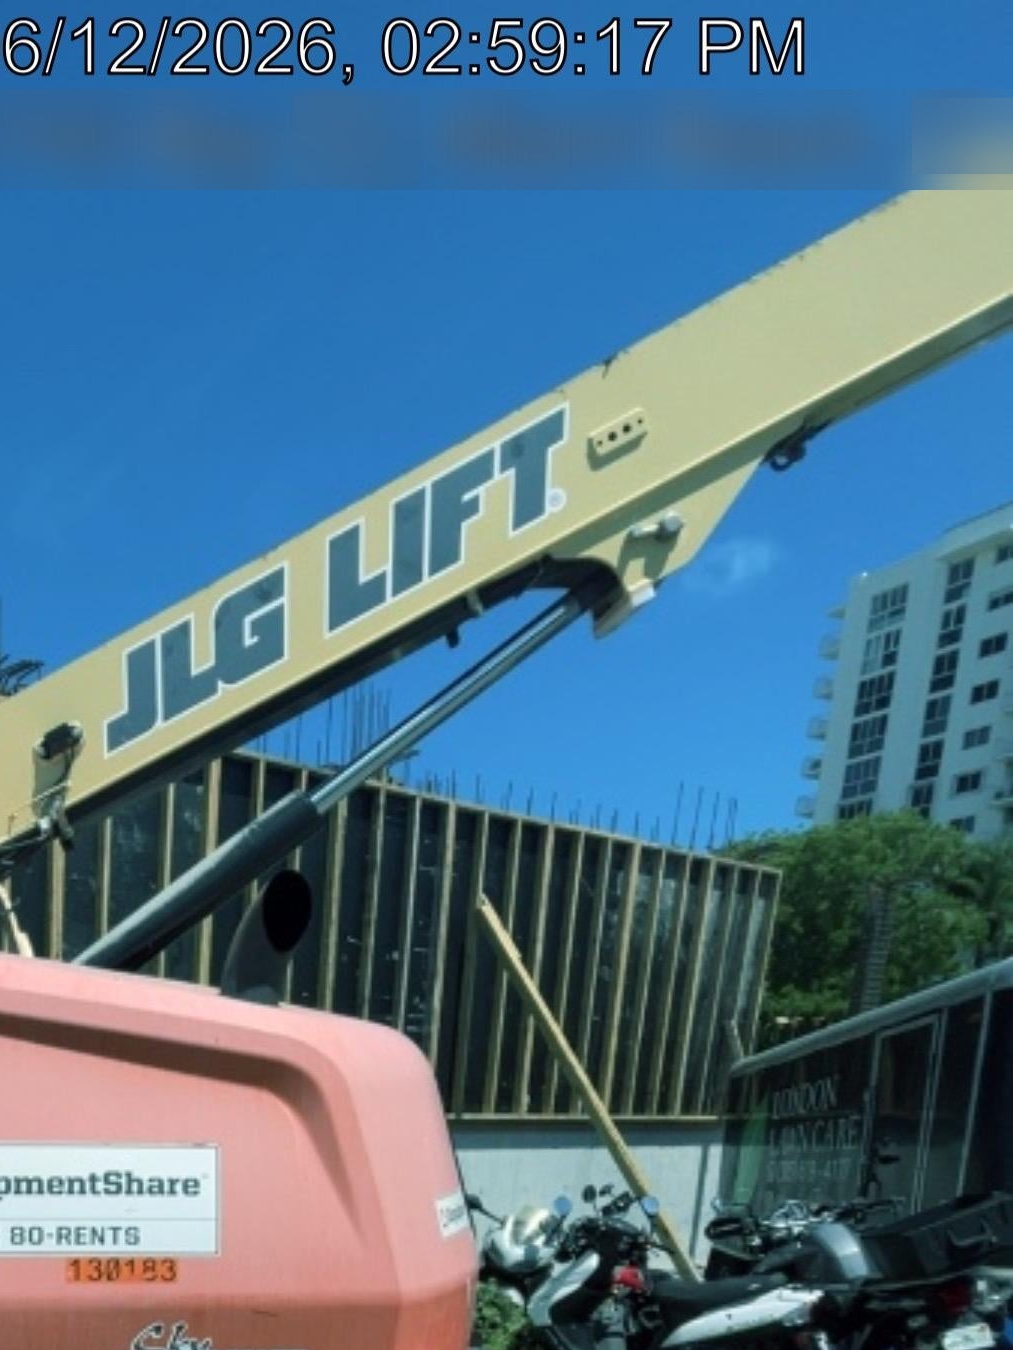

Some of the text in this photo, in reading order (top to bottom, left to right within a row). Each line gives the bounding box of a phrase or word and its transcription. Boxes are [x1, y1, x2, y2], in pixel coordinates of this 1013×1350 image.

[104, 401, 570, 760] JLG LIFT
[10, 1225, 141, 1247] 80-RENTS
[68, 1258, 177, 1282] 130183
